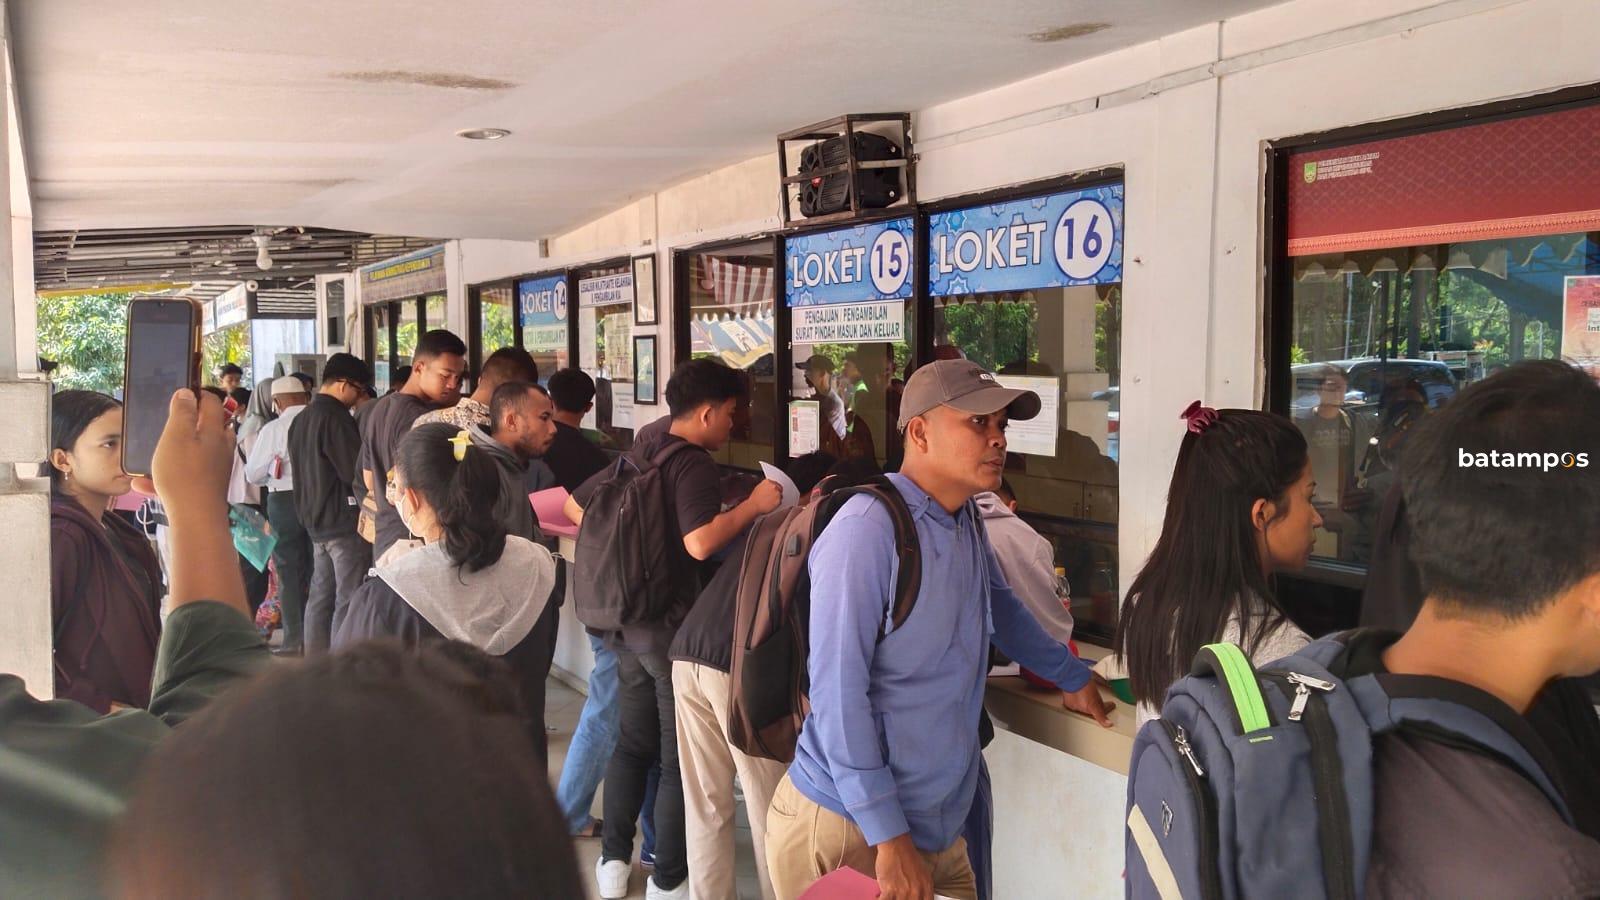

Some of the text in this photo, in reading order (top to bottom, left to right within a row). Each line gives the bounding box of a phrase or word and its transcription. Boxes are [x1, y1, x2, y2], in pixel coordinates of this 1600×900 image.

[939, 214, 1103, 274] LOKET 16
[792, 242, 902, 288] LOKET 15
[522, 287, 566, 314] LOKET 14
[805, 310, 838, 324] PENGAJUAN
[843, 305, 888, 321] PENGAMBILAN
[795, 322, 900, 340] SURAT PINDAH MASUK DAN KELUAR
